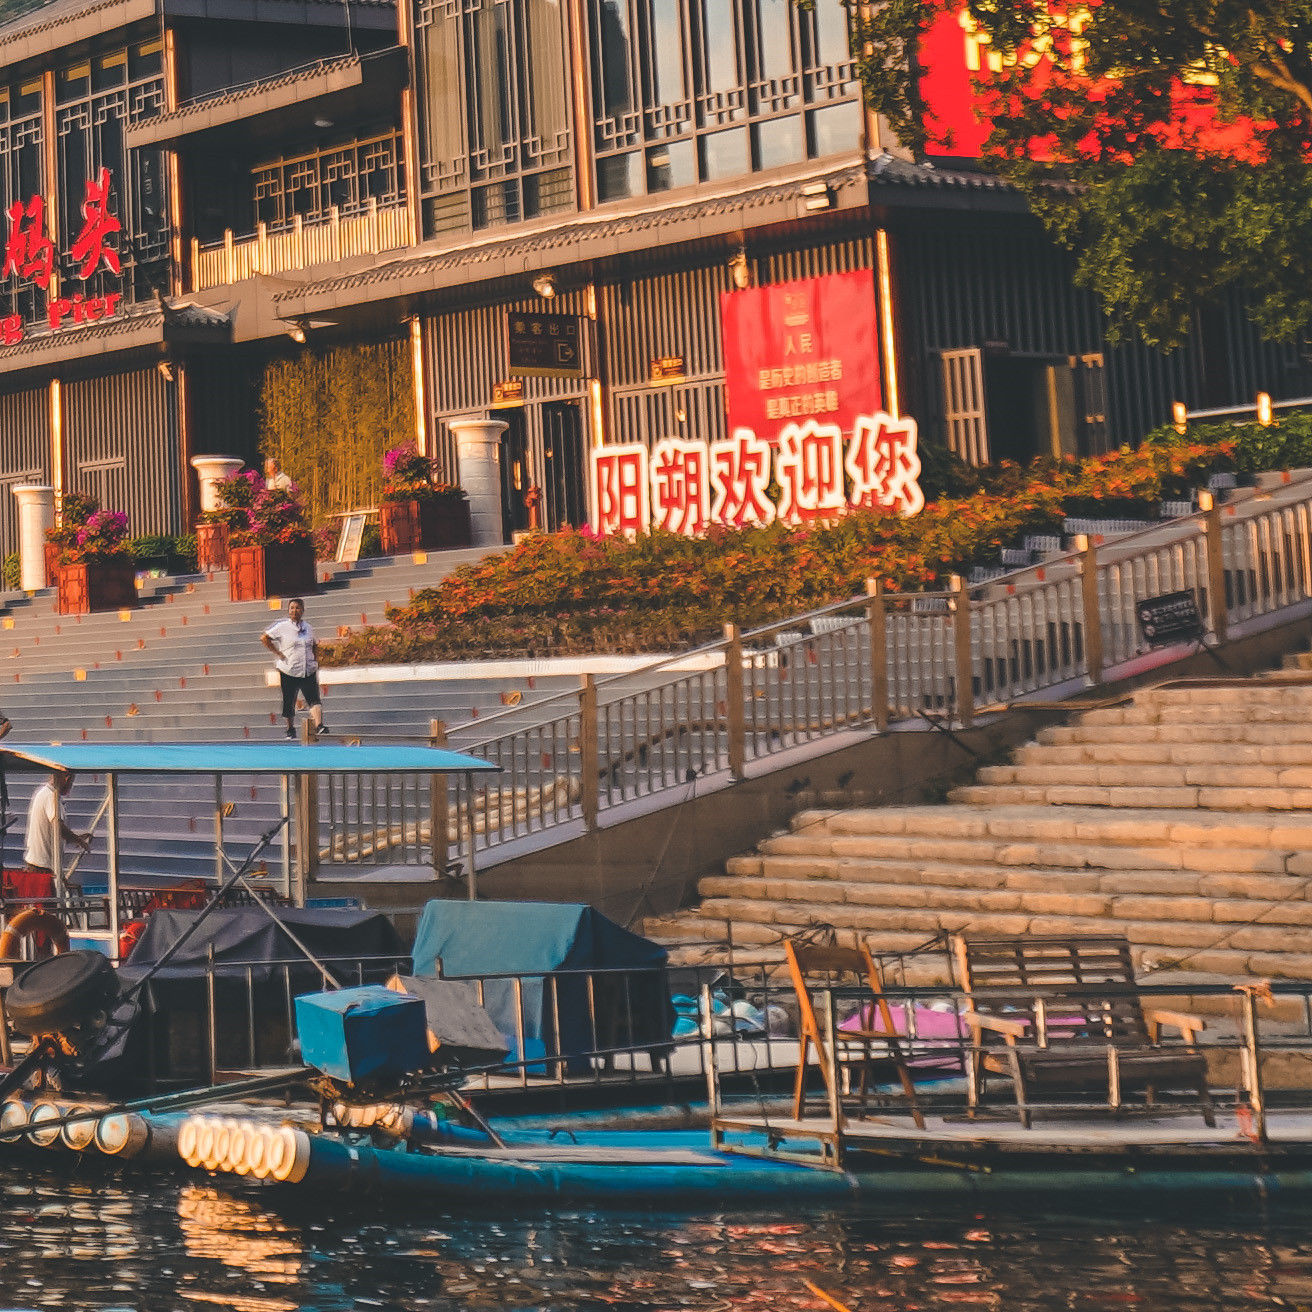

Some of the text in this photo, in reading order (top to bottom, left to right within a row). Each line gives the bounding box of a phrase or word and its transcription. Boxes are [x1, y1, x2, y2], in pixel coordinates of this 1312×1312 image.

[49, 293, 122, 329] Pier
[512, 321, 576, 336] 乘客出口
[785, 333, 813, 356] 人民
[592, 414, 924, 540] 阳朔欢迎你
